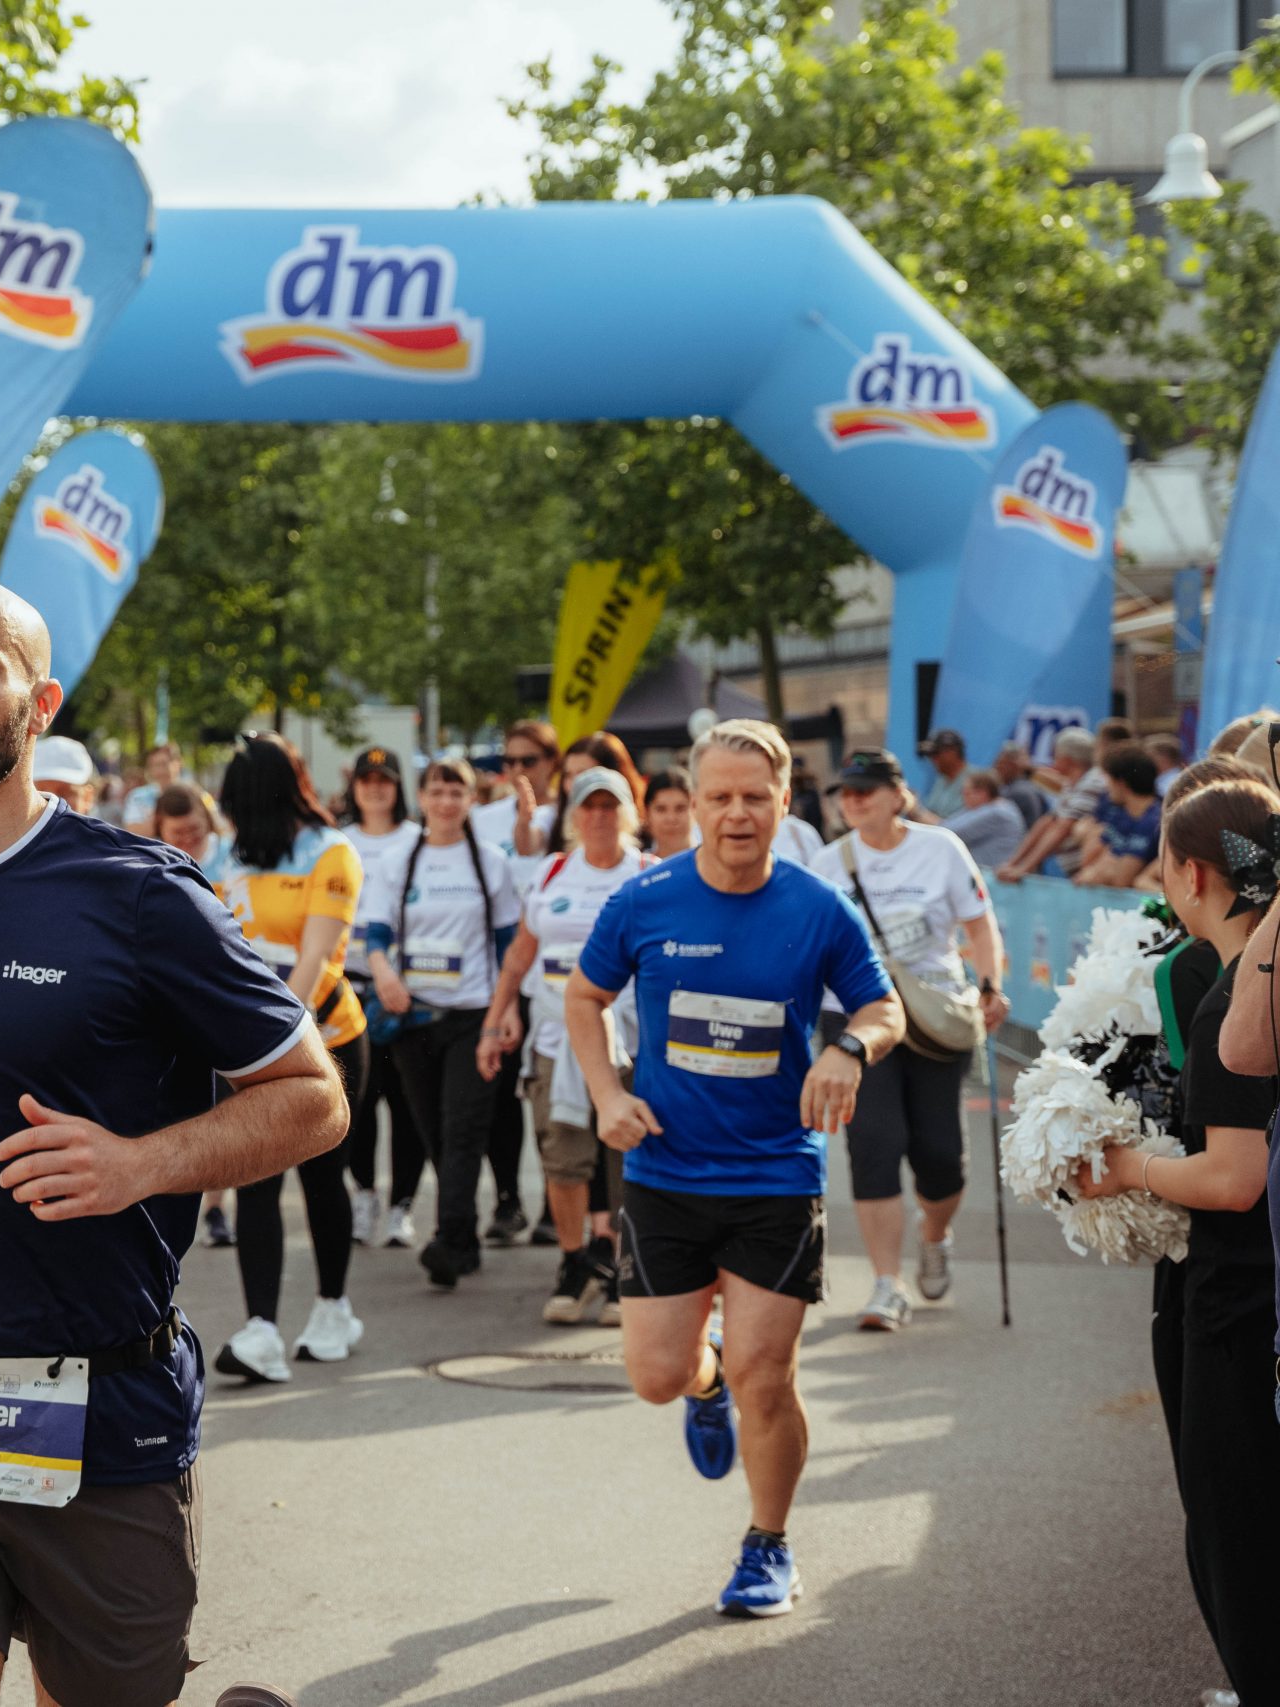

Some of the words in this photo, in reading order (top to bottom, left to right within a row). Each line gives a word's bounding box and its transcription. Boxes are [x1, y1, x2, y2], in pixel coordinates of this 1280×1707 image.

[281, 235, 443, 318] dm
[859, 343, 963, 403] dm
[63, 475, 123, 540] dm
[1022, 456, 1089, 518] dm
[564, 586, 632, 714] SPRIN
[708, 1021, 743, 1040] Uwe
